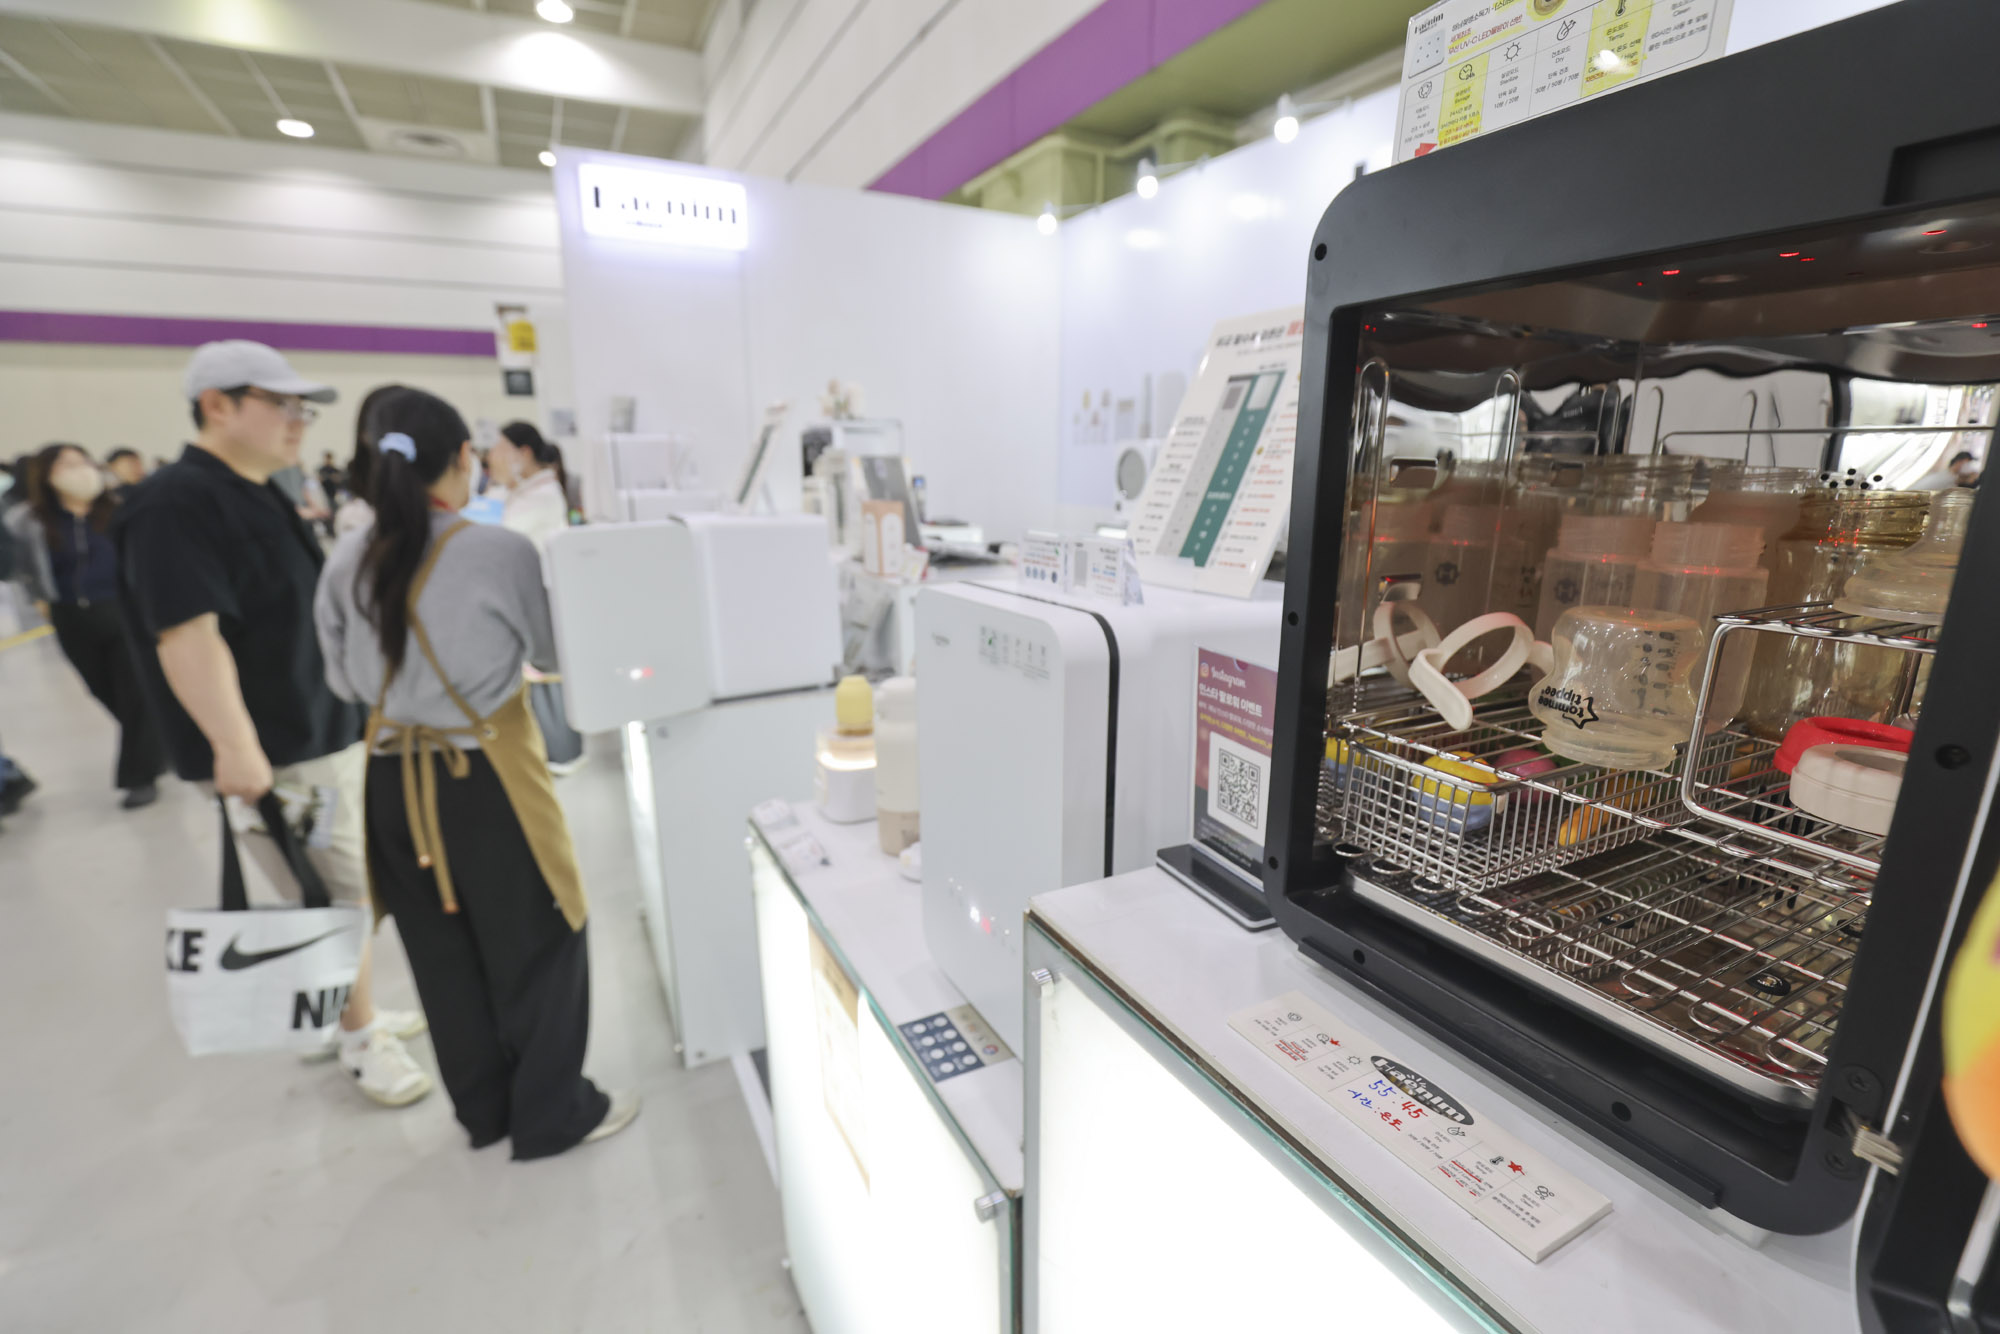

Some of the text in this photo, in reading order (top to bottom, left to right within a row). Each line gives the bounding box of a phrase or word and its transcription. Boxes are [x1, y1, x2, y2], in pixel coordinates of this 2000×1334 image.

[1538, 695, 1585, 718] tommee
[1368, 1080, 1397, 1097] 55
[1401, 1101, 1429, 1119] 45
